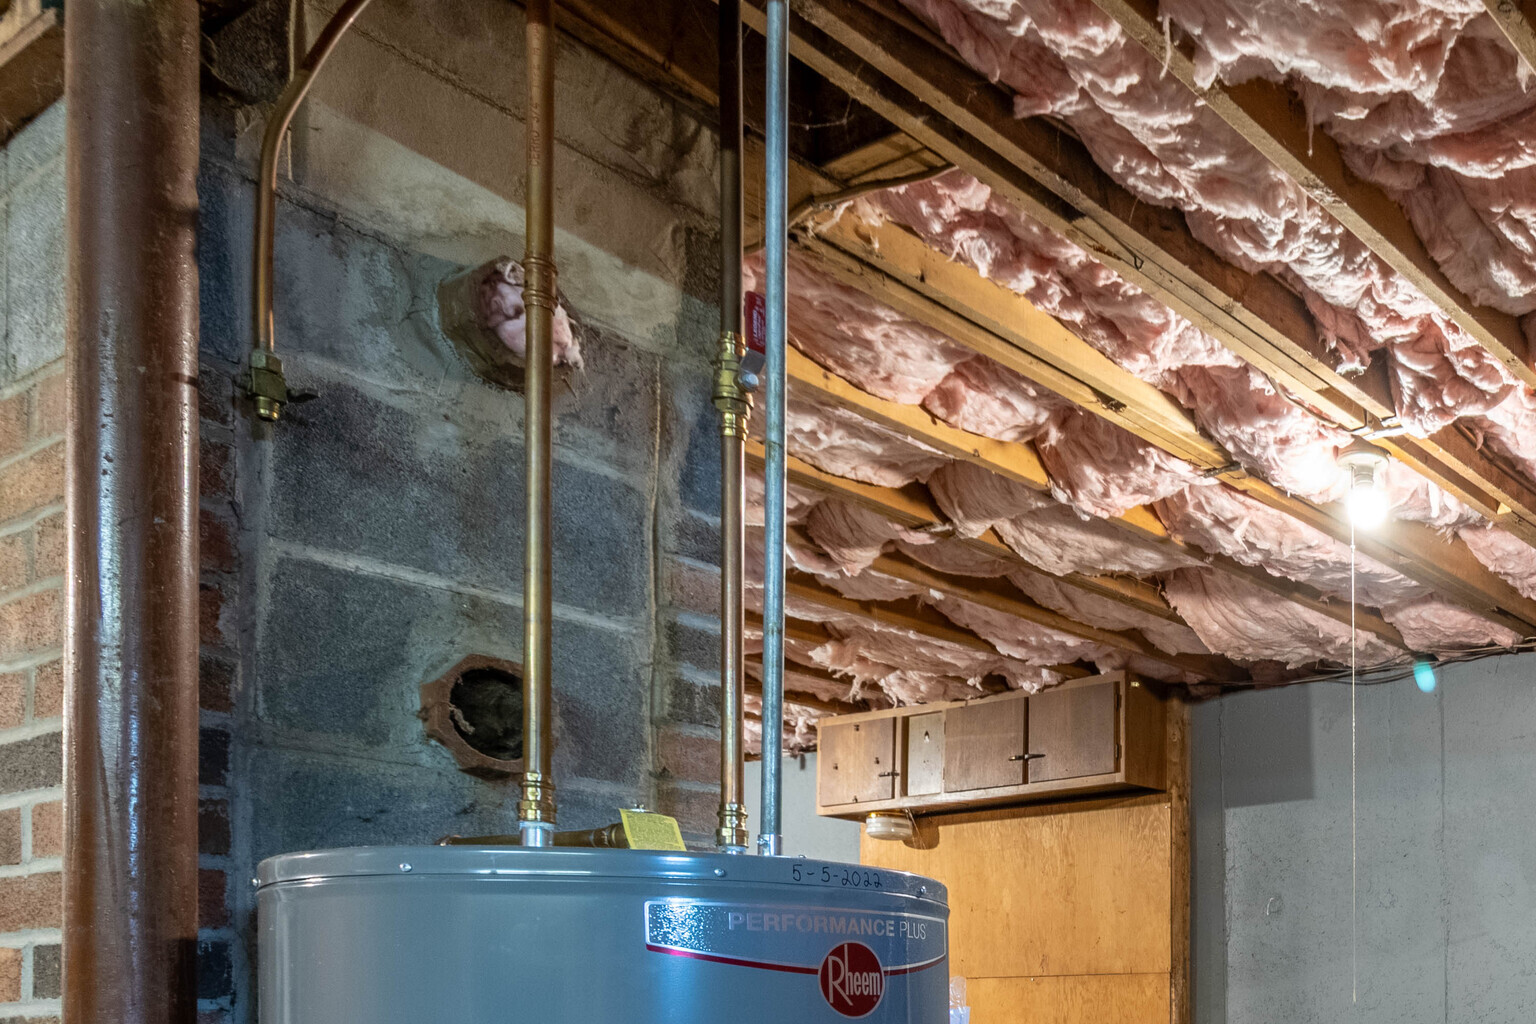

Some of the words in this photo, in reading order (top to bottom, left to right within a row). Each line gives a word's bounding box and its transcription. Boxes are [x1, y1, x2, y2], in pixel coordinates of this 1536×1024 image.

[728, 911, 895, 937] PERFORMANCE
[899, 920, 927, 941] PLUS
[828, 943, 881, 1006] Rheem
